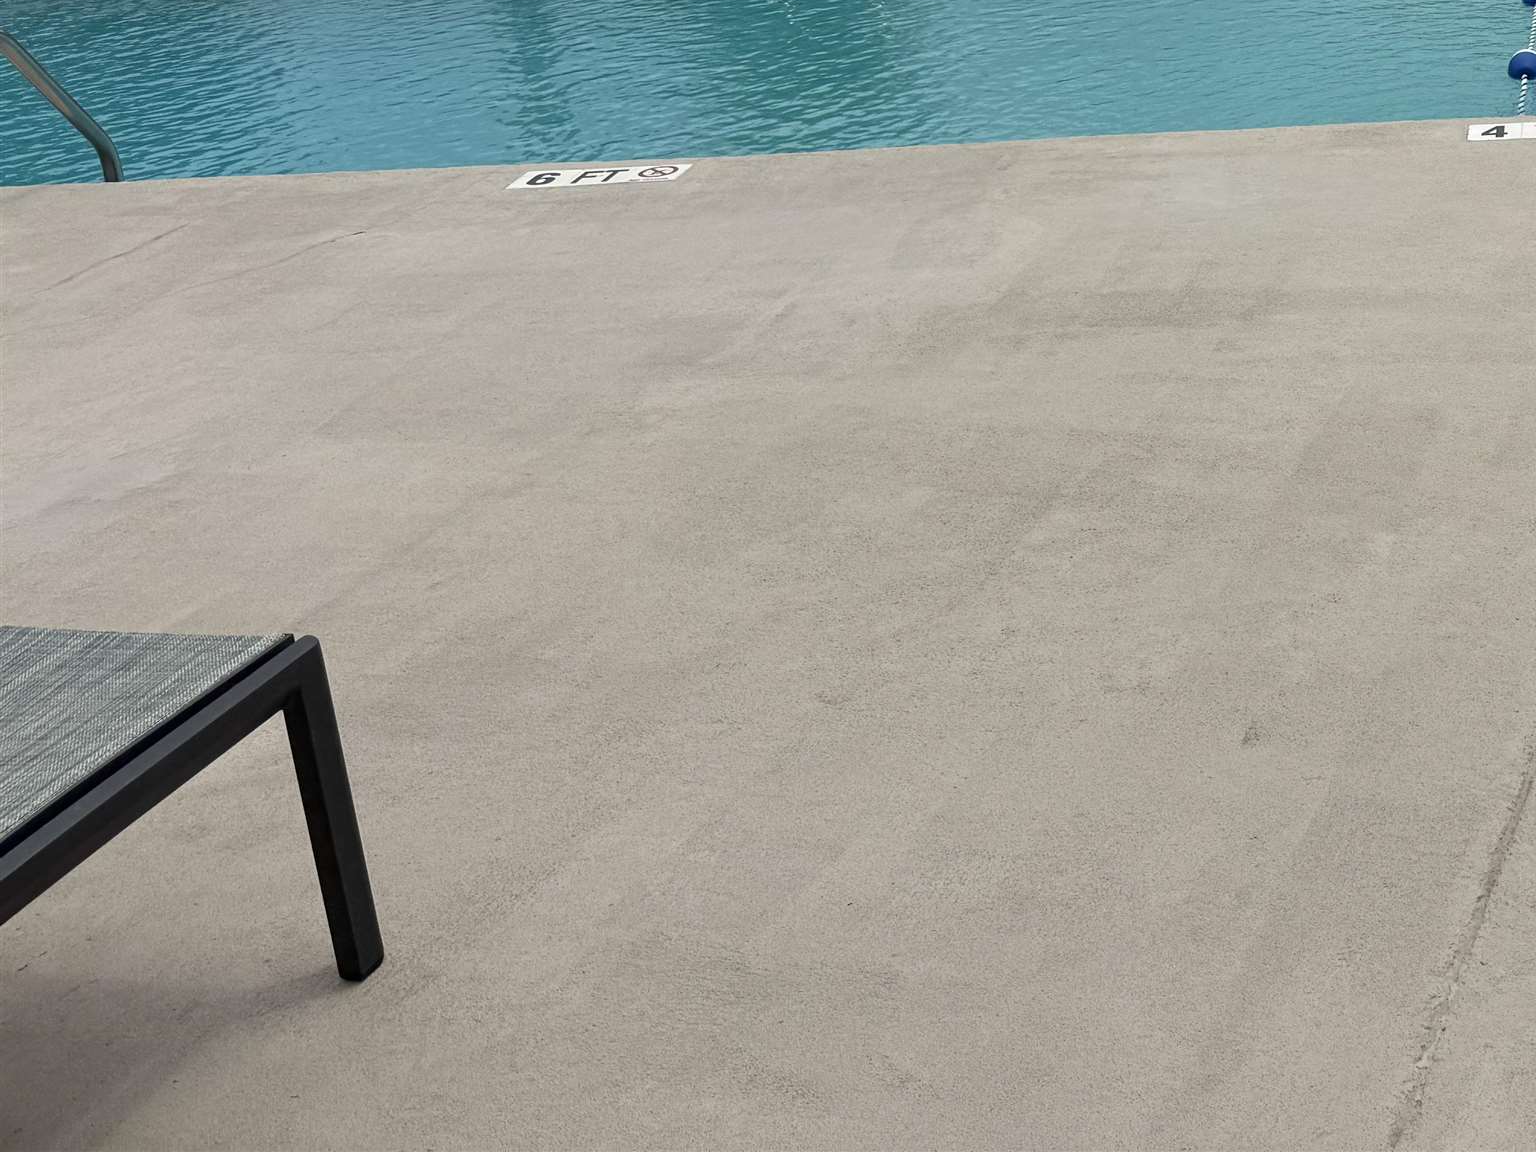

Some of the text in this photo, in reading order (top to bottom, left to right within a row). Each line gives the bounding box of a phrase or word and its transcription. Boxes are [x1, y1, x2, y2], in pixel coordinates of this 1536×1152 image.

[1481, 125, 1508, 138] 4
[526, 172, 561, 186] 6
[570, 169, 629, 184] FT
